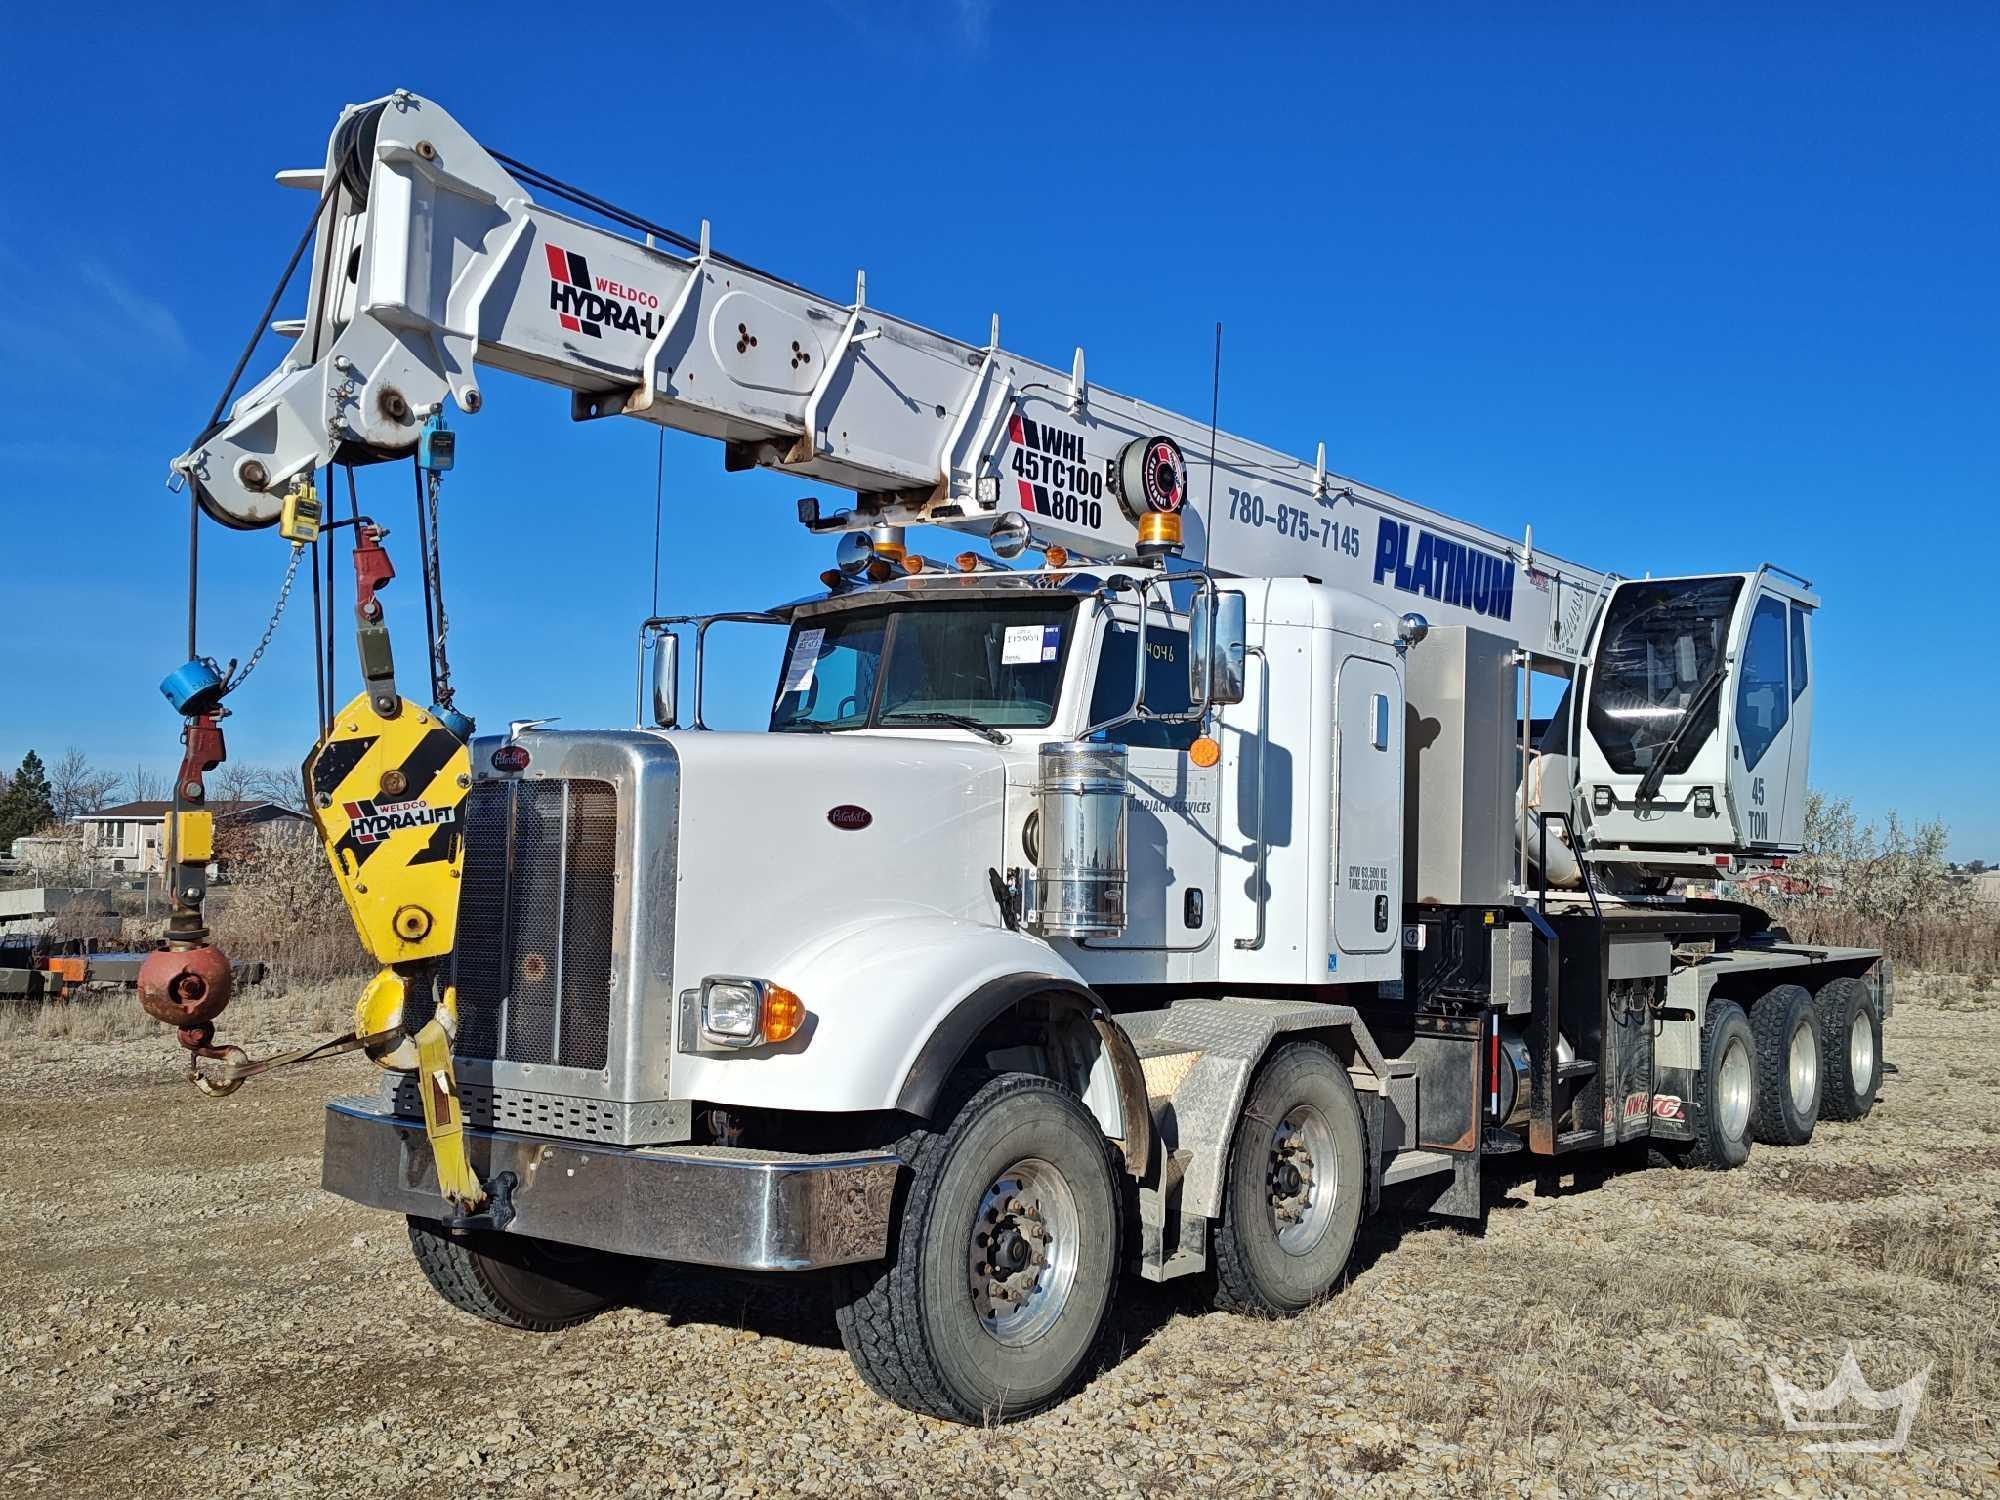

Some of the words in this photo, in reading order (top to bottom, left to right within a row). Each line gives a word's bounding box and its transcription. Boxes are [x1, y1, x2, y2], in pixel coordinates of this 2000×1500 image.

[550, 279, 665, 341] HYDRA-LI
[595, 276, 659, 309] WELDCO
[1041, 423, 1087, 466] WHL
[1011, 447, 1103, 500] 45TC100
[1051, 490, 1102, 530] 8010
[1228, 486, 1360, 559] 780-875-7145
[1373, 516, 1516, 622] PLATINUM
[379, 800, 427, 813] WELDCO
[1127, 799, 1170, 813] UMPJACK
[1173, 801, 1212, 814] SERVICES
[1751, 776, 1765, 806] 45
[351, 806, 453, 836] HYDRA-LIFT
[1748, 810, 1768, 841] TON
